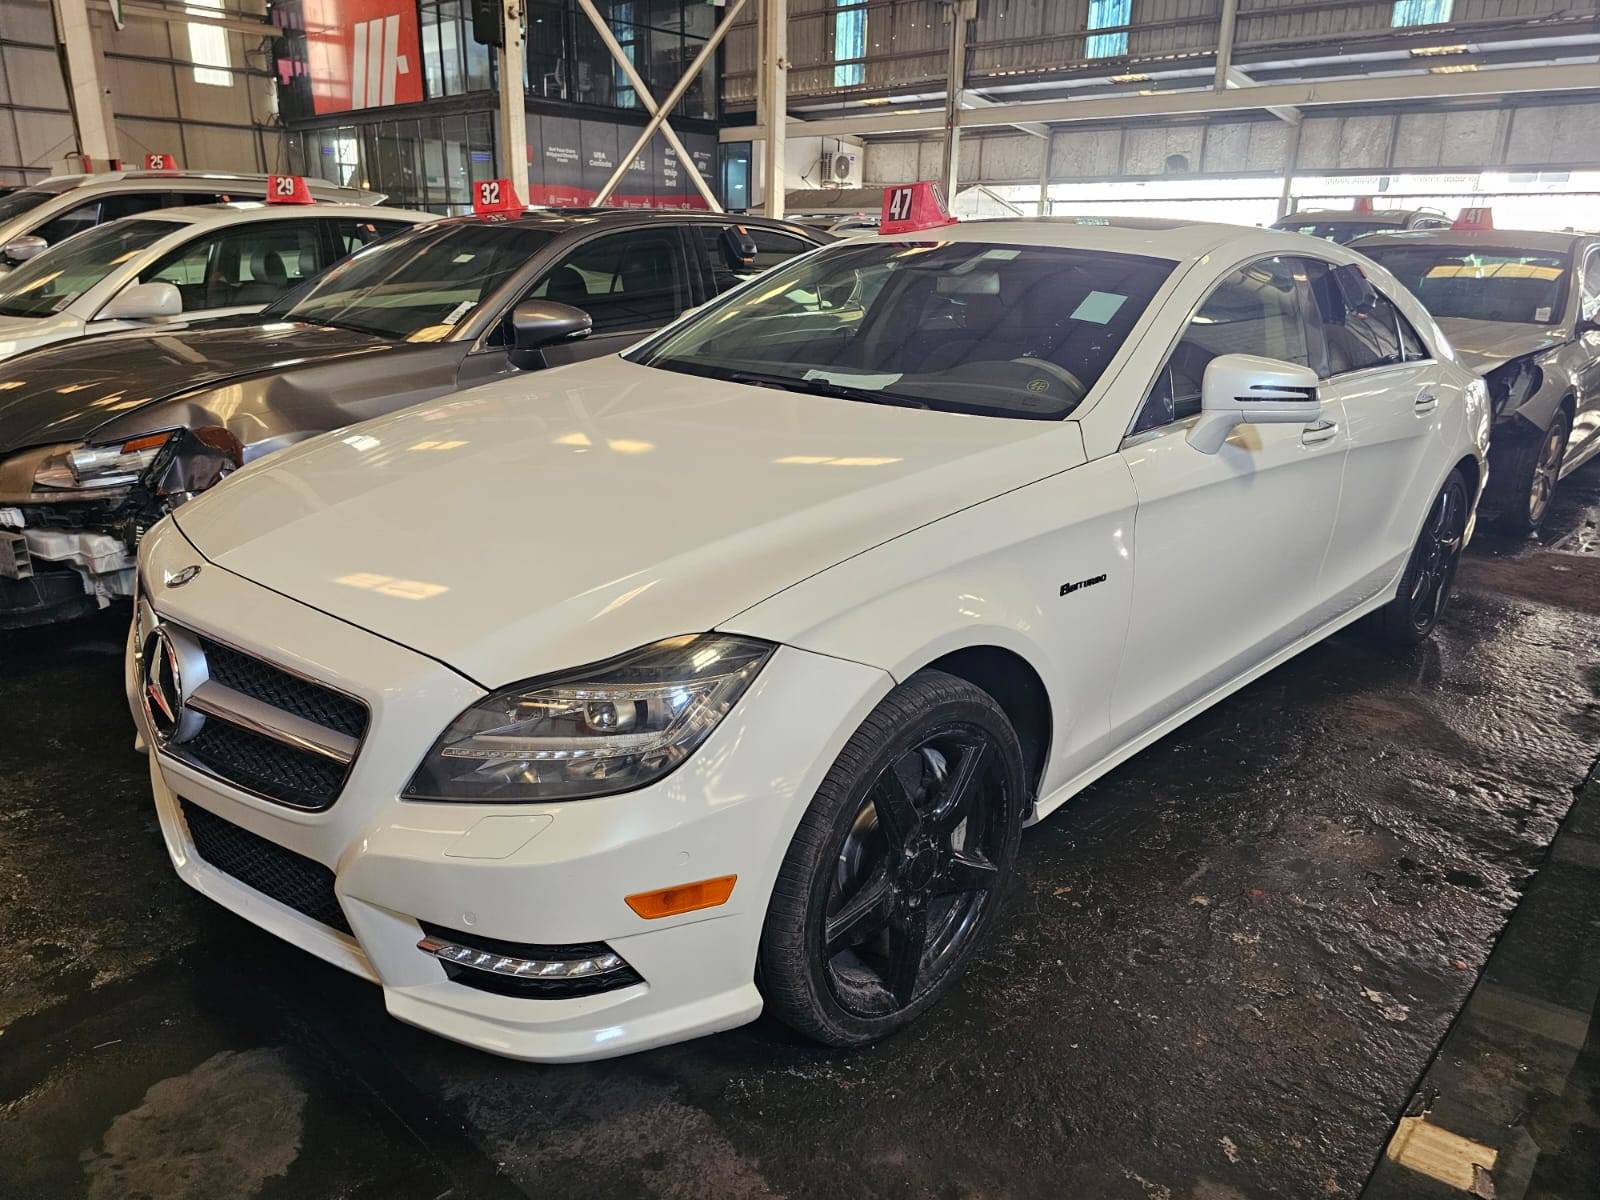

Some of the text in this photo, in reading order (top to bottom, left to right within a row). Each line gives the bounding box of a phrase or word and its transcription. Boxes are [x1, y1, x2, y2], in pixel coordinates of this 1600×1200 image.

[150, 155, 164, 169] 25
[276, 177, 294, 195] 29
[481, 182, 500, 205] 32
[890, 188, 912, 220] 47
